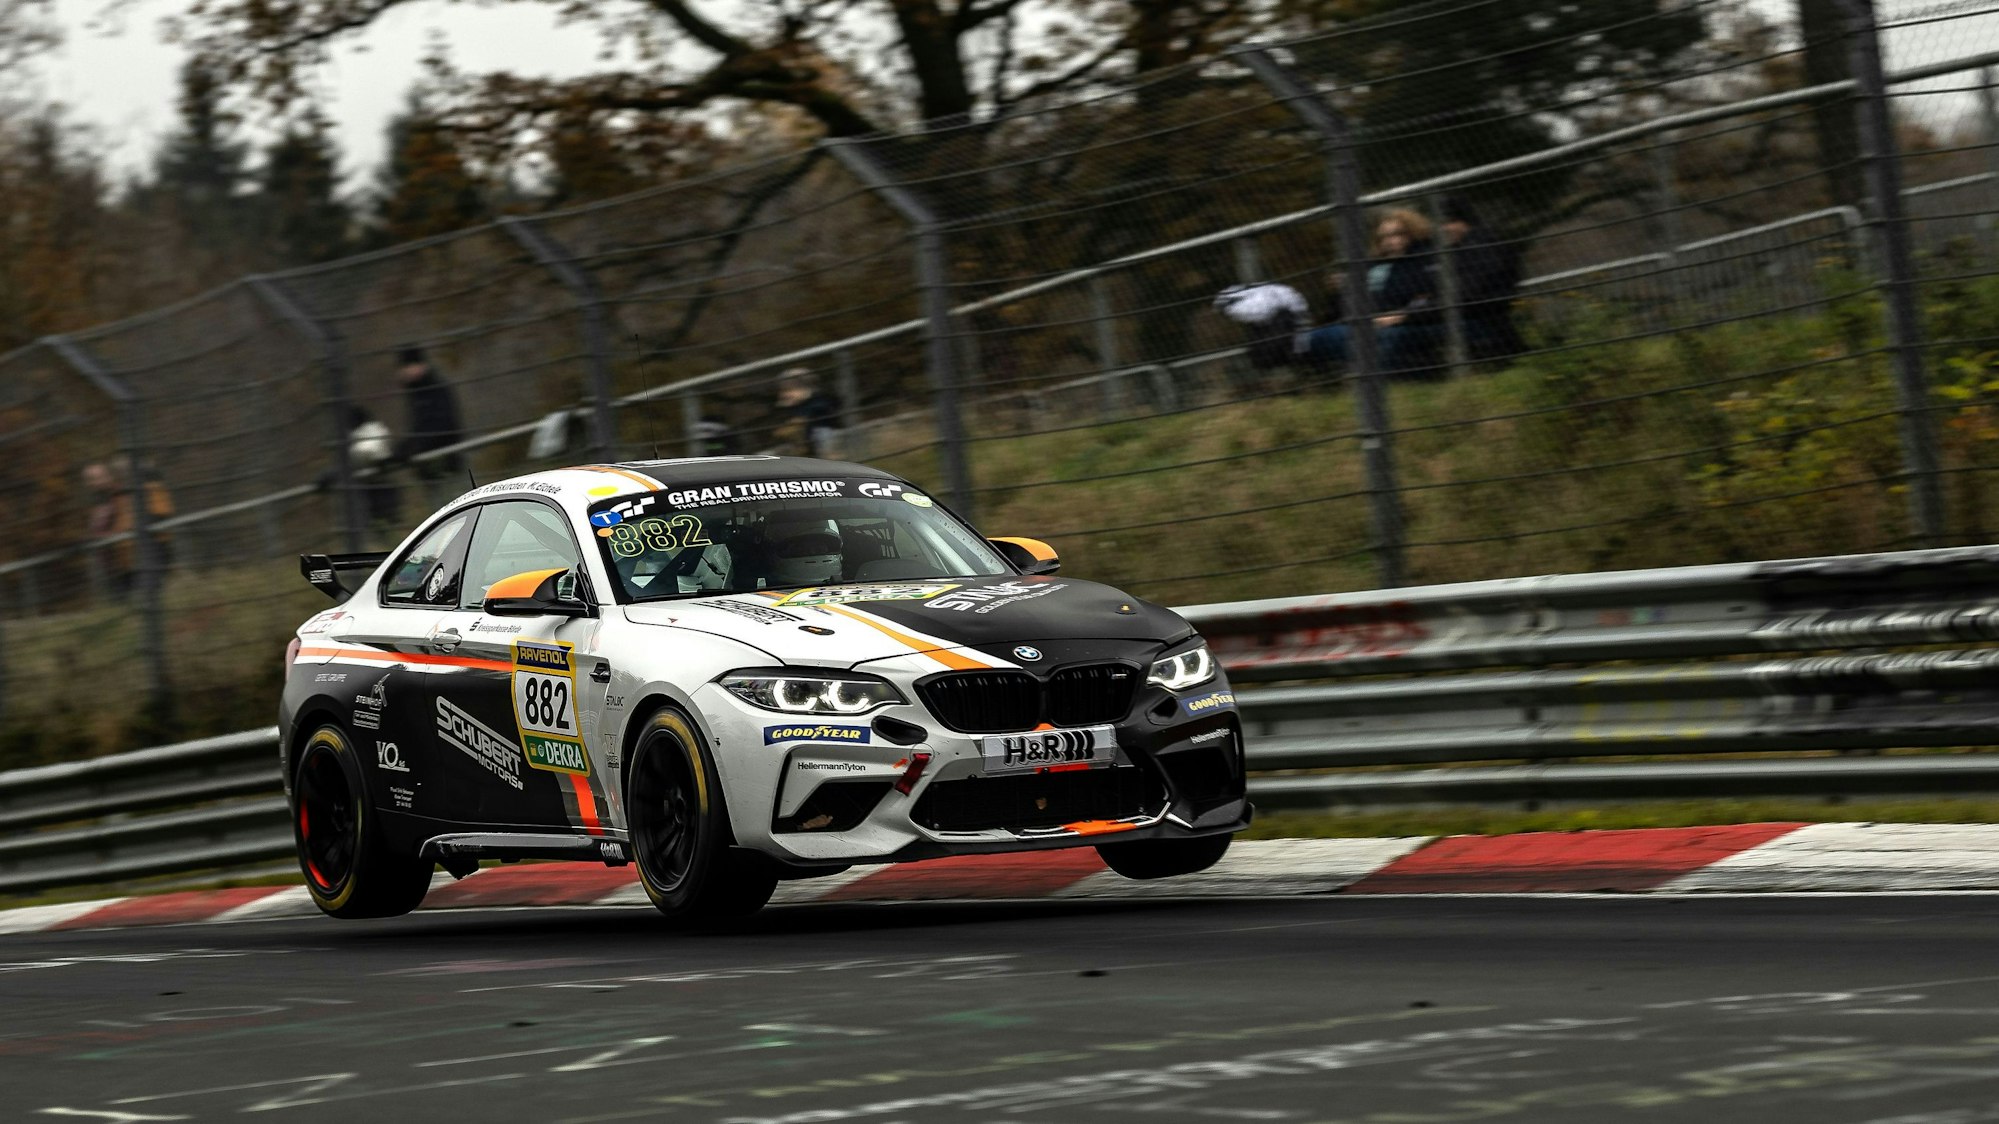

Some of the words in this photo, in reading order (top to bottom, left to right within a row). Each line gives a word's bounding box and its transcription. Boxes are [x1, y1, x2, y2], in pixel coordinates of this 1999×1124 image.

[667, 486, 733, 506] GRAN
[675, 503, 699, 511] THE
[700, 499, 730, 507] REAL
[731, 494, 777, 503] DRIVING
[779, 492, 843, 500] SIMULATOR
[595, 512, 612, 525] T
[607, 514, 713, 557] 882
[520, 647, 566, 665] RAVENOL
[525, 677, 570, 730] 882
[436, 695, 521, 776] SCHUBERT
[772, 726, 861, 739] GOODYEAR
[544, 741, 585, 769] DEKRA
[477, 753, 518, 789] MOTORS
[797, 762, 866, 772] HellermannTyton
